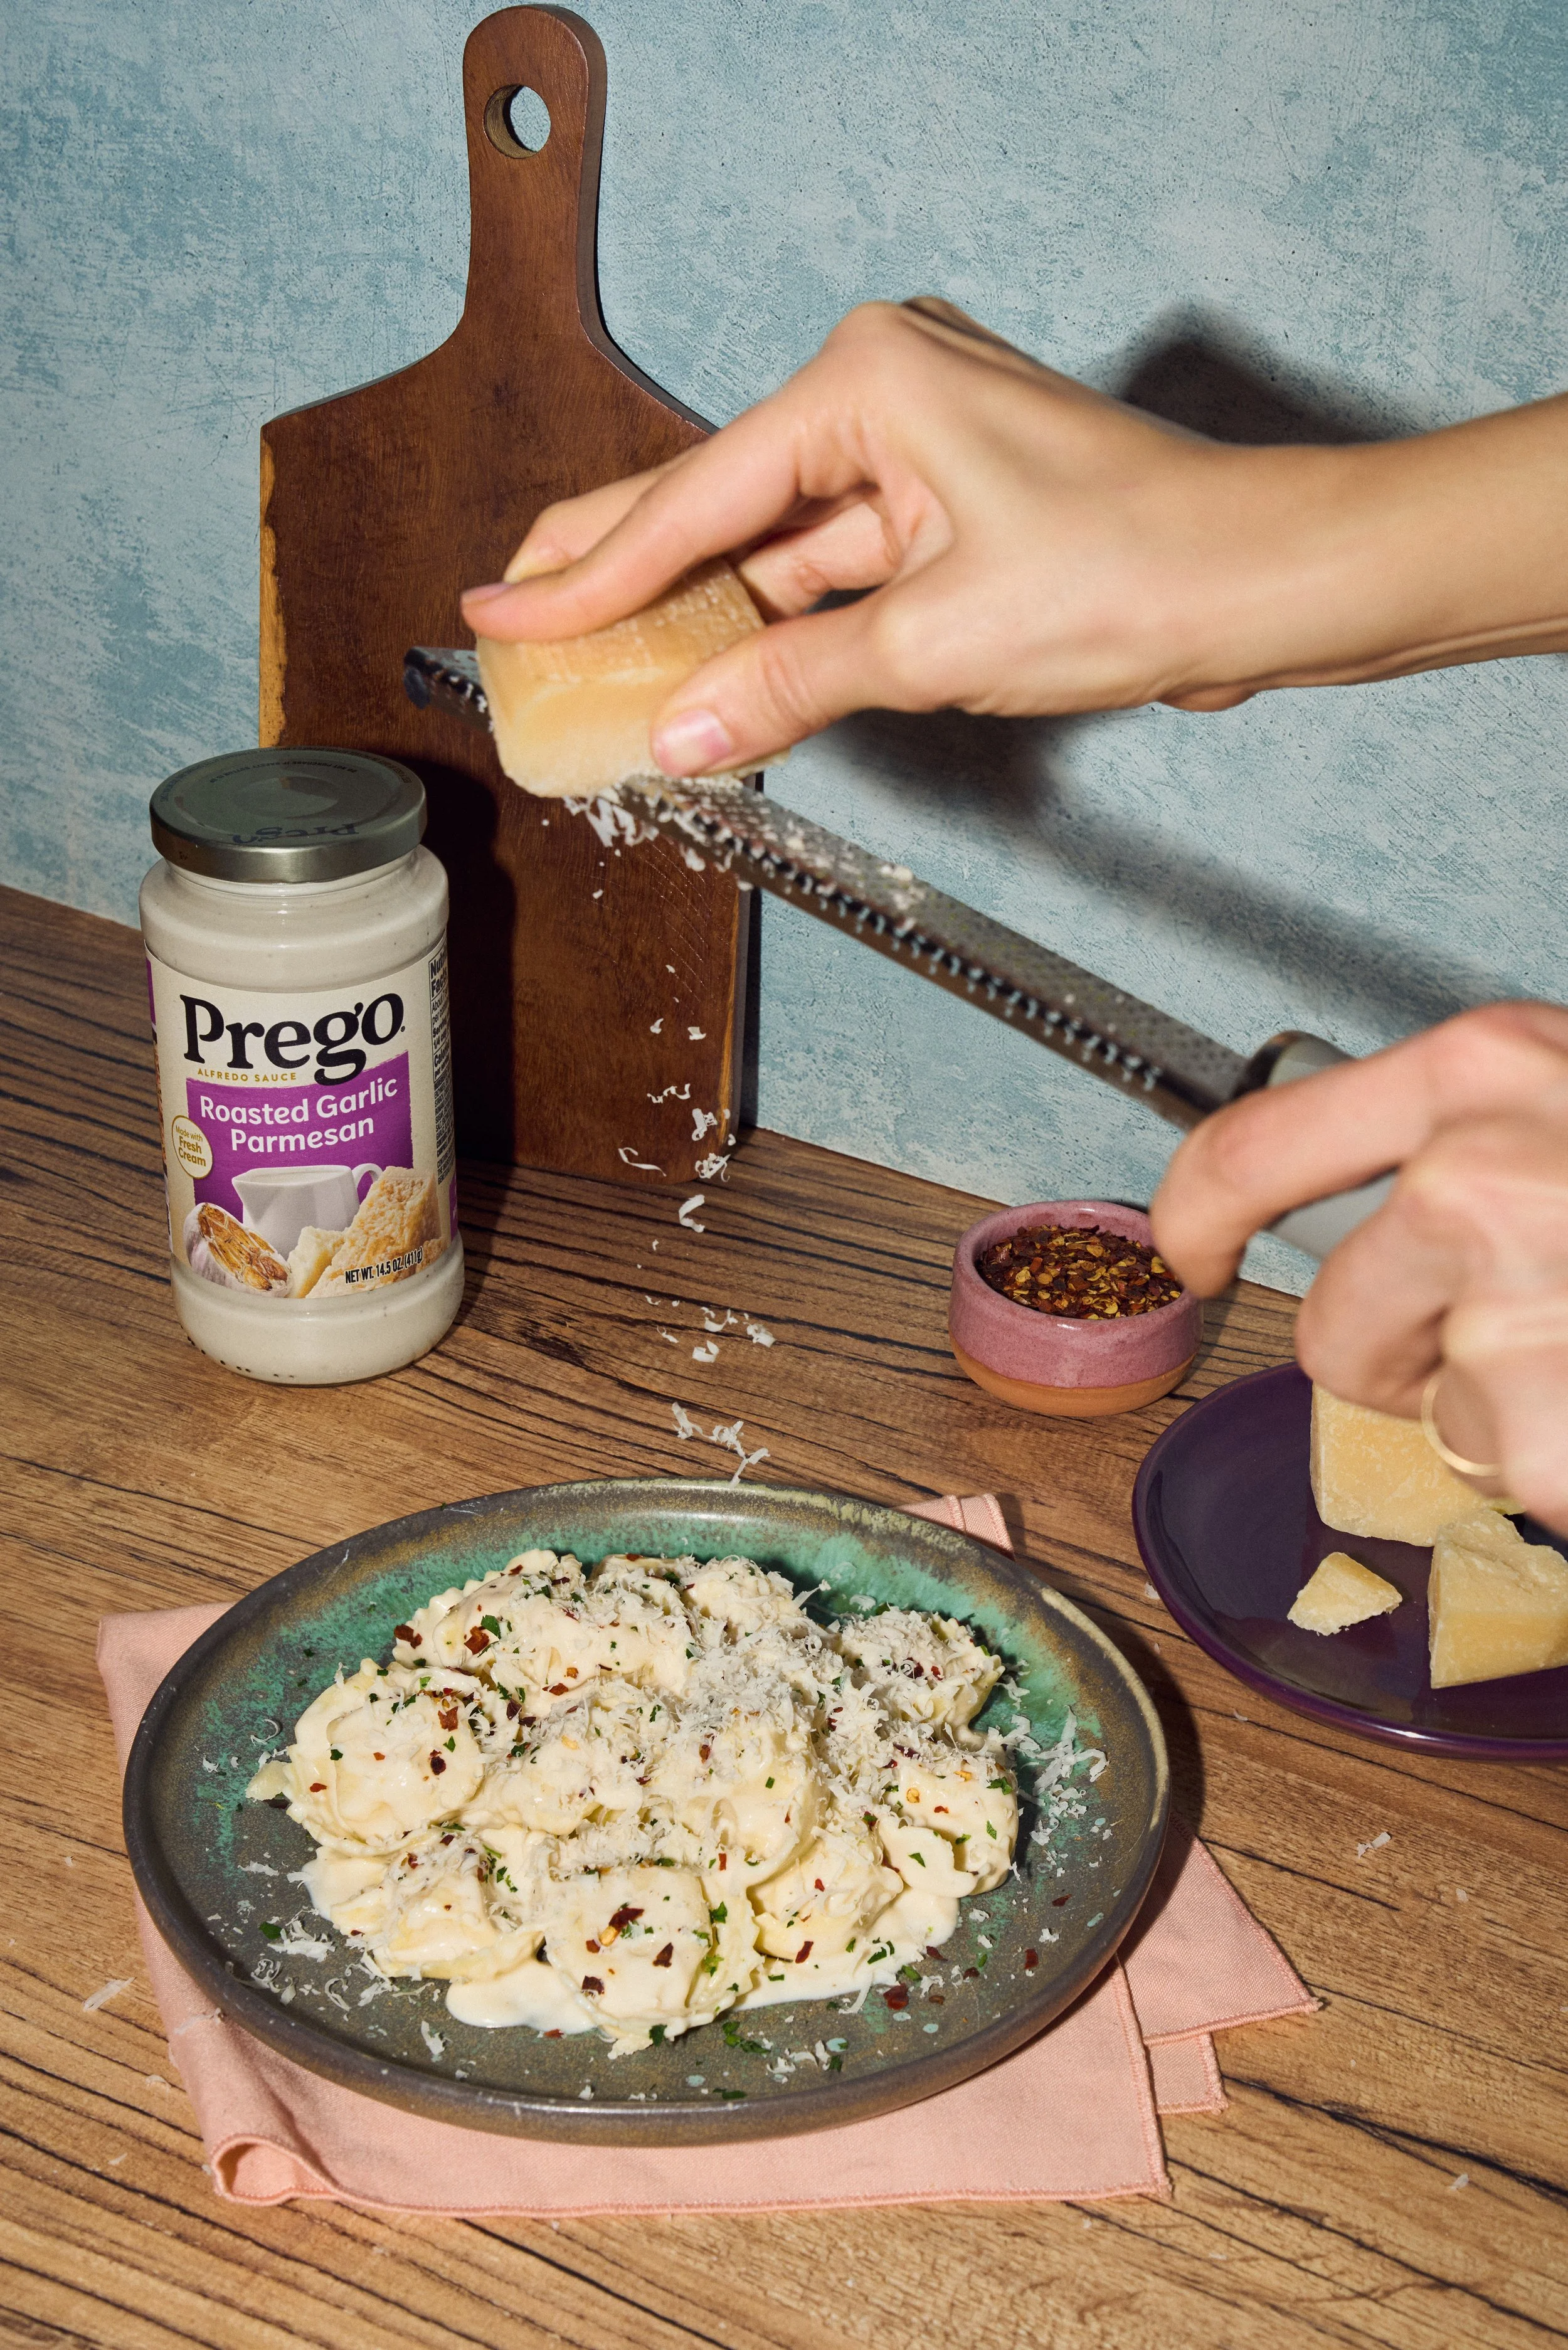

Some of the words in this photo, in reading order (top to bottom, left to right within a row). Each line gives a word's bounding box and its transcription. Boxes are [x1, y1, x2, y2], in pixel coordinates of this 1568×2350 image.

[232, 823, 359, 844] Prego
[179, 993, 405, 1086] Prego
[198, 1068, 248, 1082] ALFREDO
[255, 1072, 297, 1082] SAUCE
[200, 1096, 309, 1125] Roasted
[317, 1078, 398, 1119] Garlic
[176, 1125, 189, 1138] Made
[190, 1133, 203, 1142] with
[231, 1118, 374, 1153] Parmesan
[179, 1136, 202, 1154] Fresh
[178, 1147, 206, 1167] Cream
[345, 1269, 359, 1284] NET
[361, 1266, 374, 1281] WT.
[376, 1261, 391, 1277] 14.5
[404, 1247, 423, 1268] (411g)
